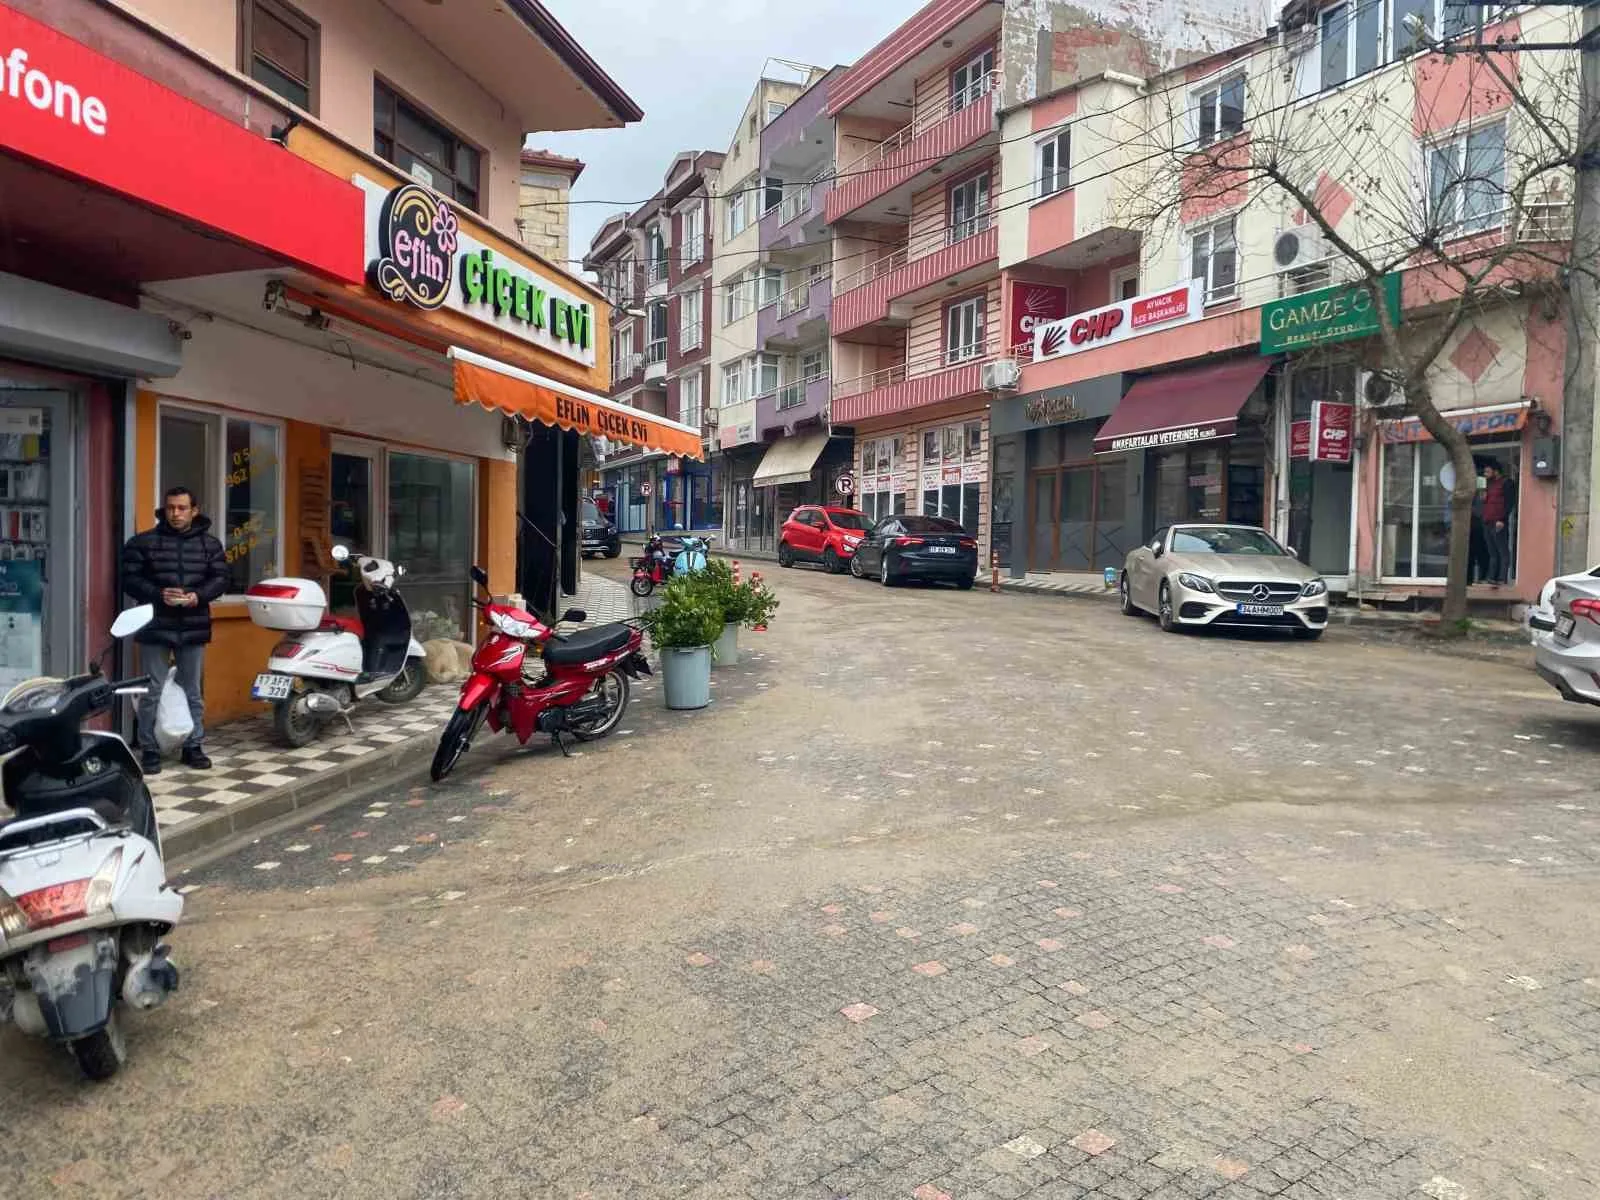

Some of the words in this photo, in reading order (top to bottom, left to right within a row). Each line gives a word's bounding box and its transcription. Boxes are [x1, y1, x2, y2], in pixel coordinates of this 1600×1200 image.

[1070, 309, 1124, 345] CHP
[1269, 295, 1347, 331] GAMZE
[1322, 428, 1348, 440] CHP
